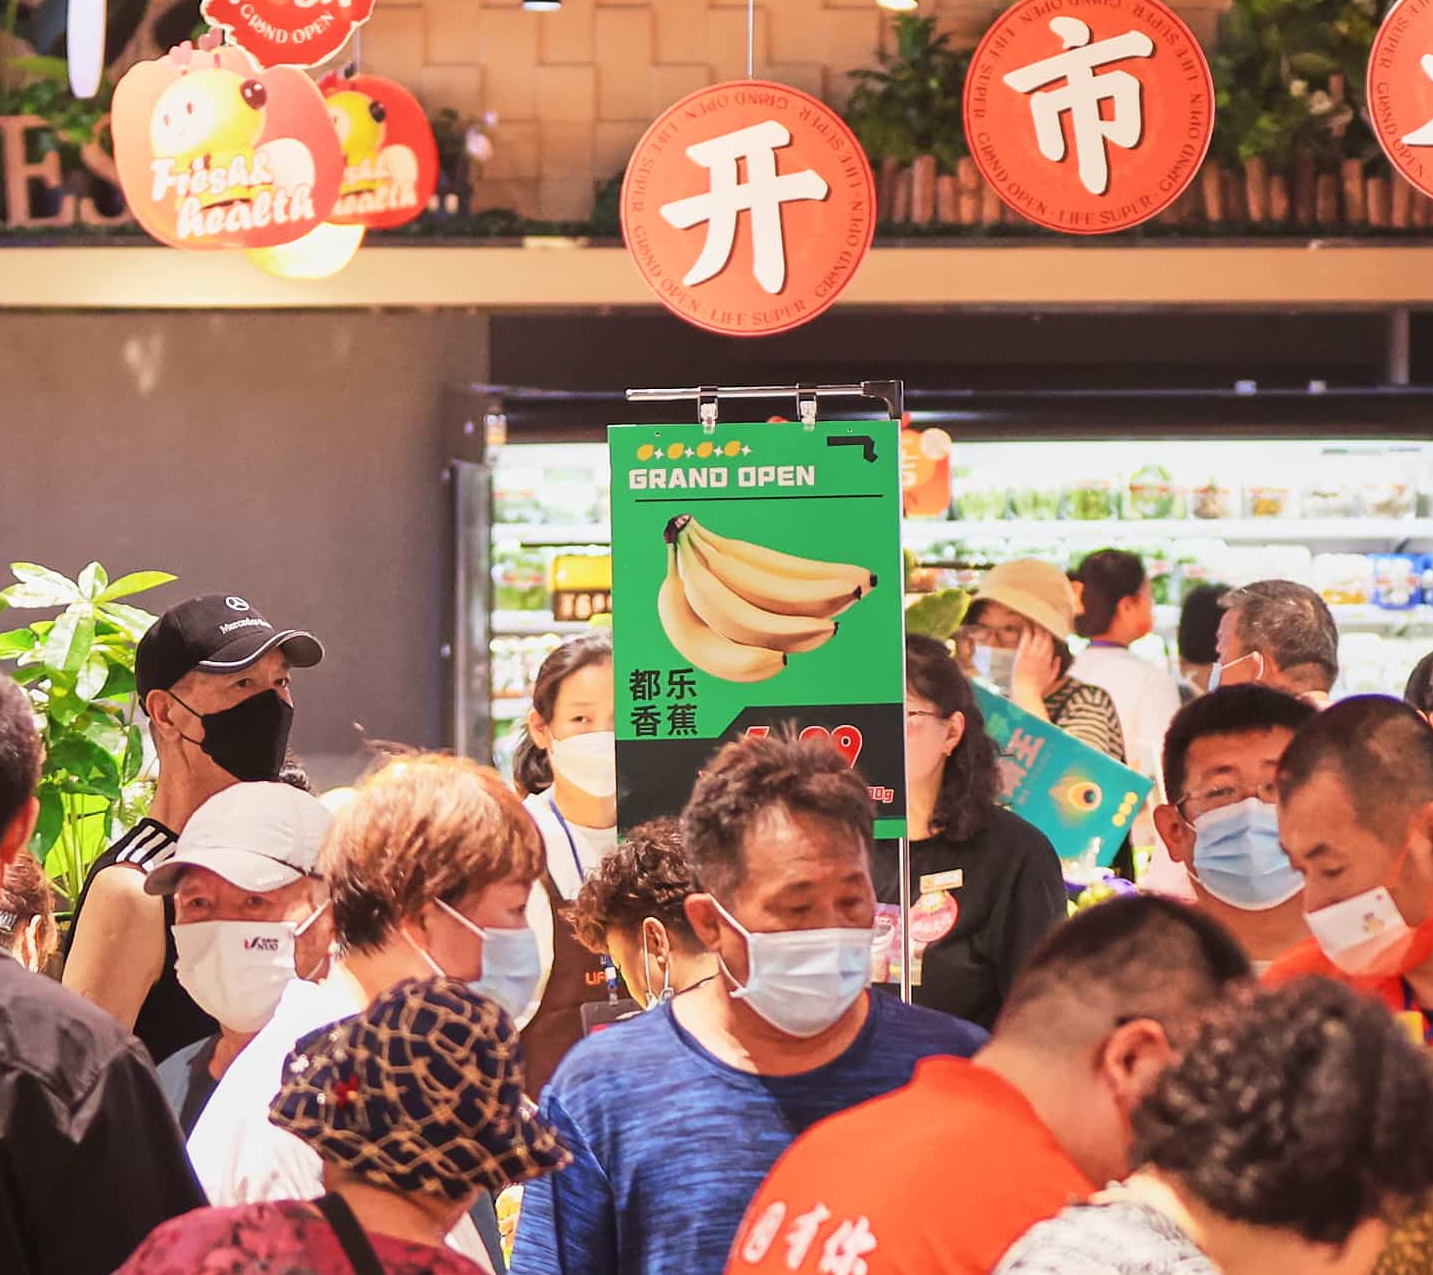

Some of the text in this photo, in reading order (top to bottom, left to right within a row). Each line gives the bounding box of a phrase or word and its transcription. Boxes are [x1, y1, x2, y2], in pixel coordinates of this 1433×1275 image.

[292, 10, 334, 44] OPEN
[1002, 16, 1154, 194] 市
[176, 185, 314, 239] health
[660, 120, 829, 294] 开
[629, 465, 815, 489] GRAND OPEN
[629, 667, 697, 701] 都乐
[630, 704, 699, 737] 香蕉
